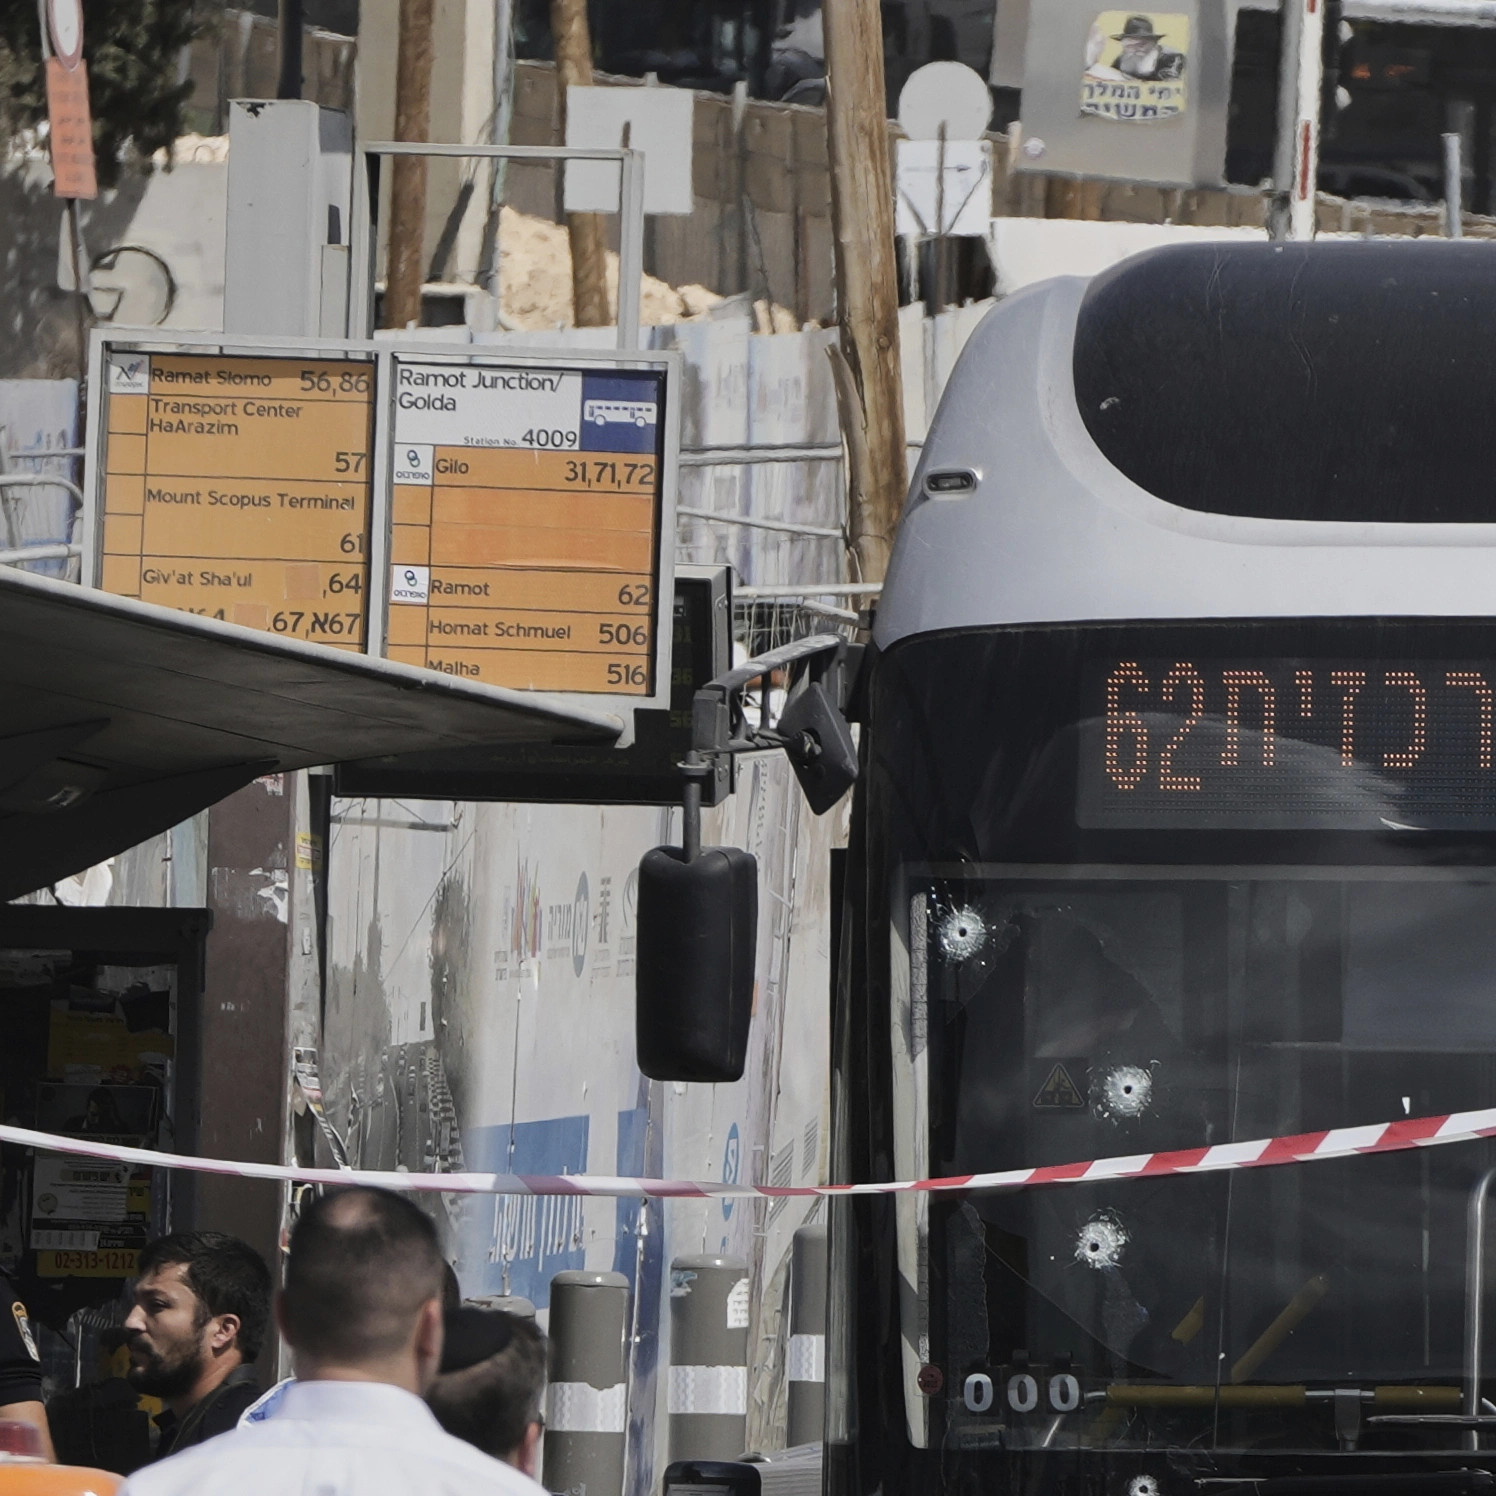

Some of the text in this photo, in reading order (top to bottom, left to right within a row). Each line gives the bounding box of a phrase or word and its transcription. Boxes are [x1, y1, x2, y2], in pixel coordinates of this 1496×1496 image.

[151, 367, 212, 385] Ramat
[300, 370, 371, 397] 56,86
[399, 369, 563, 393] Ramot Junction/
[151, 398, 303, 418] Transport Center
[399, 392, 457, 412] Golda
[149, 418, 239, 436] HaArazim
[522, 429, 577, 448] 4009
[334, 451, 368, 473] 57
[436, 459, 655, 490] Gilo 31,71,72
[146, 488, 355, 510] Mount Scopus Terminal
[340, 532, 364, 554] 61
[142, 569, 194, 586] Giv'at
[200, 571, 253, 588] Sha'ul
[430, 579, 650, 606] Ramot 62
[430, 619, 649, 646] Homat Schmuel 506
[428, 660, 647, 686] Malha 516
[1104, 662, 1202, 791] 62
